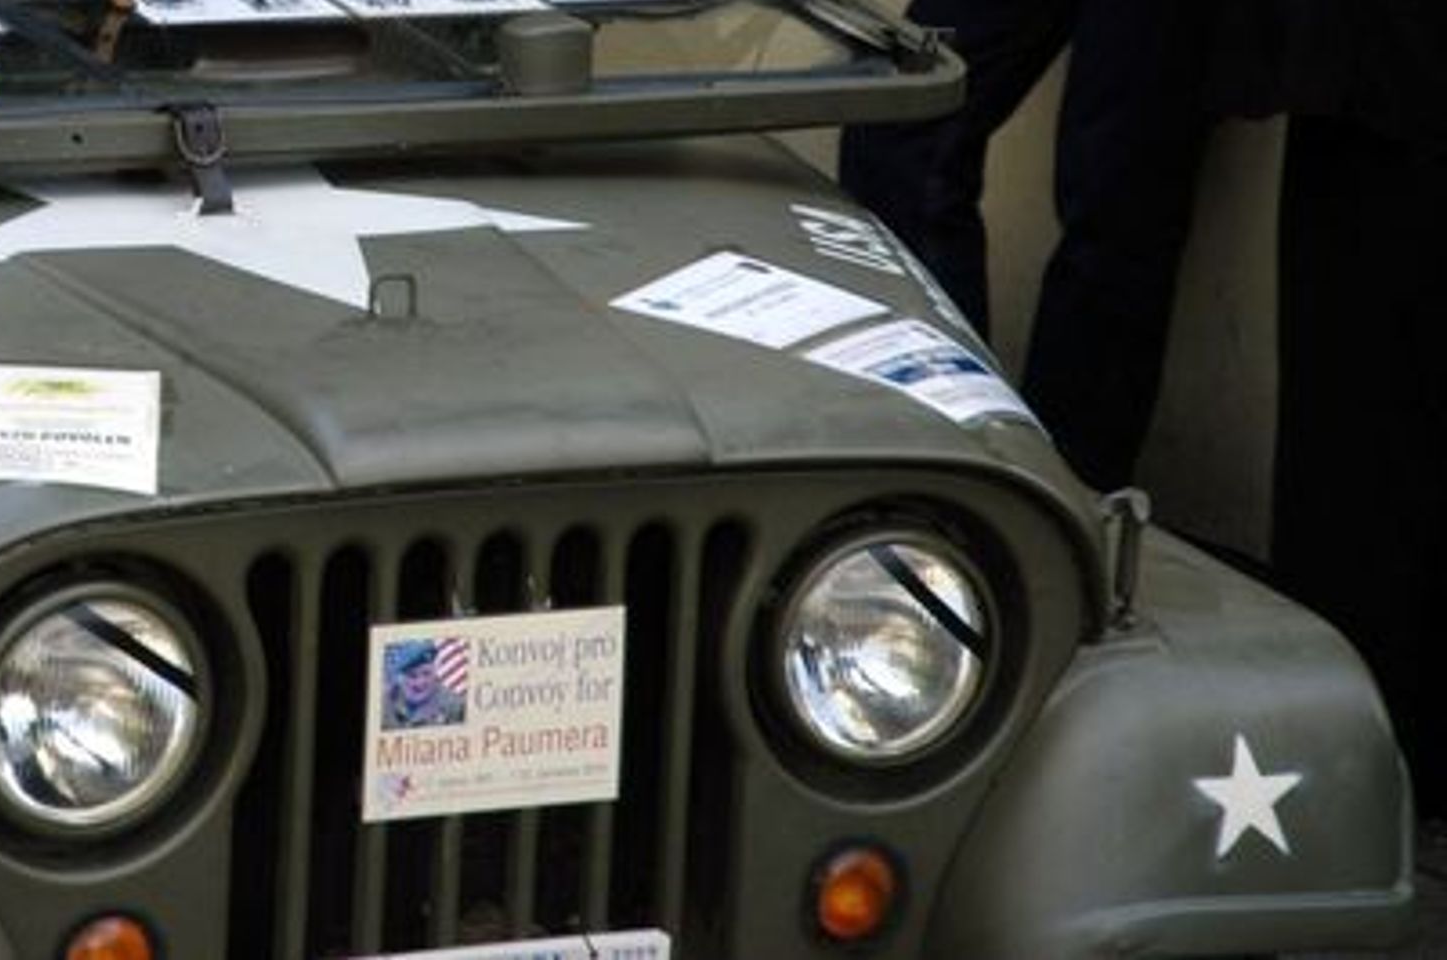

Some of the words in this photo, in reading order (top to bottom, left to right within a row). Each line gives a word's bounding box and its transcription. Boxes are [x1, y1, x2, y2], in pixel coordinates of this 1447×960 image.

[476, 635, 566, 669] Konvoj
[575, 634, 617, 668] pro
[474, 678, 569, 712] Convoy
[577, 671, 614, 702] for
[376, 733, 471, 769] Milana
[481, 723, 609, 759] Paumera
